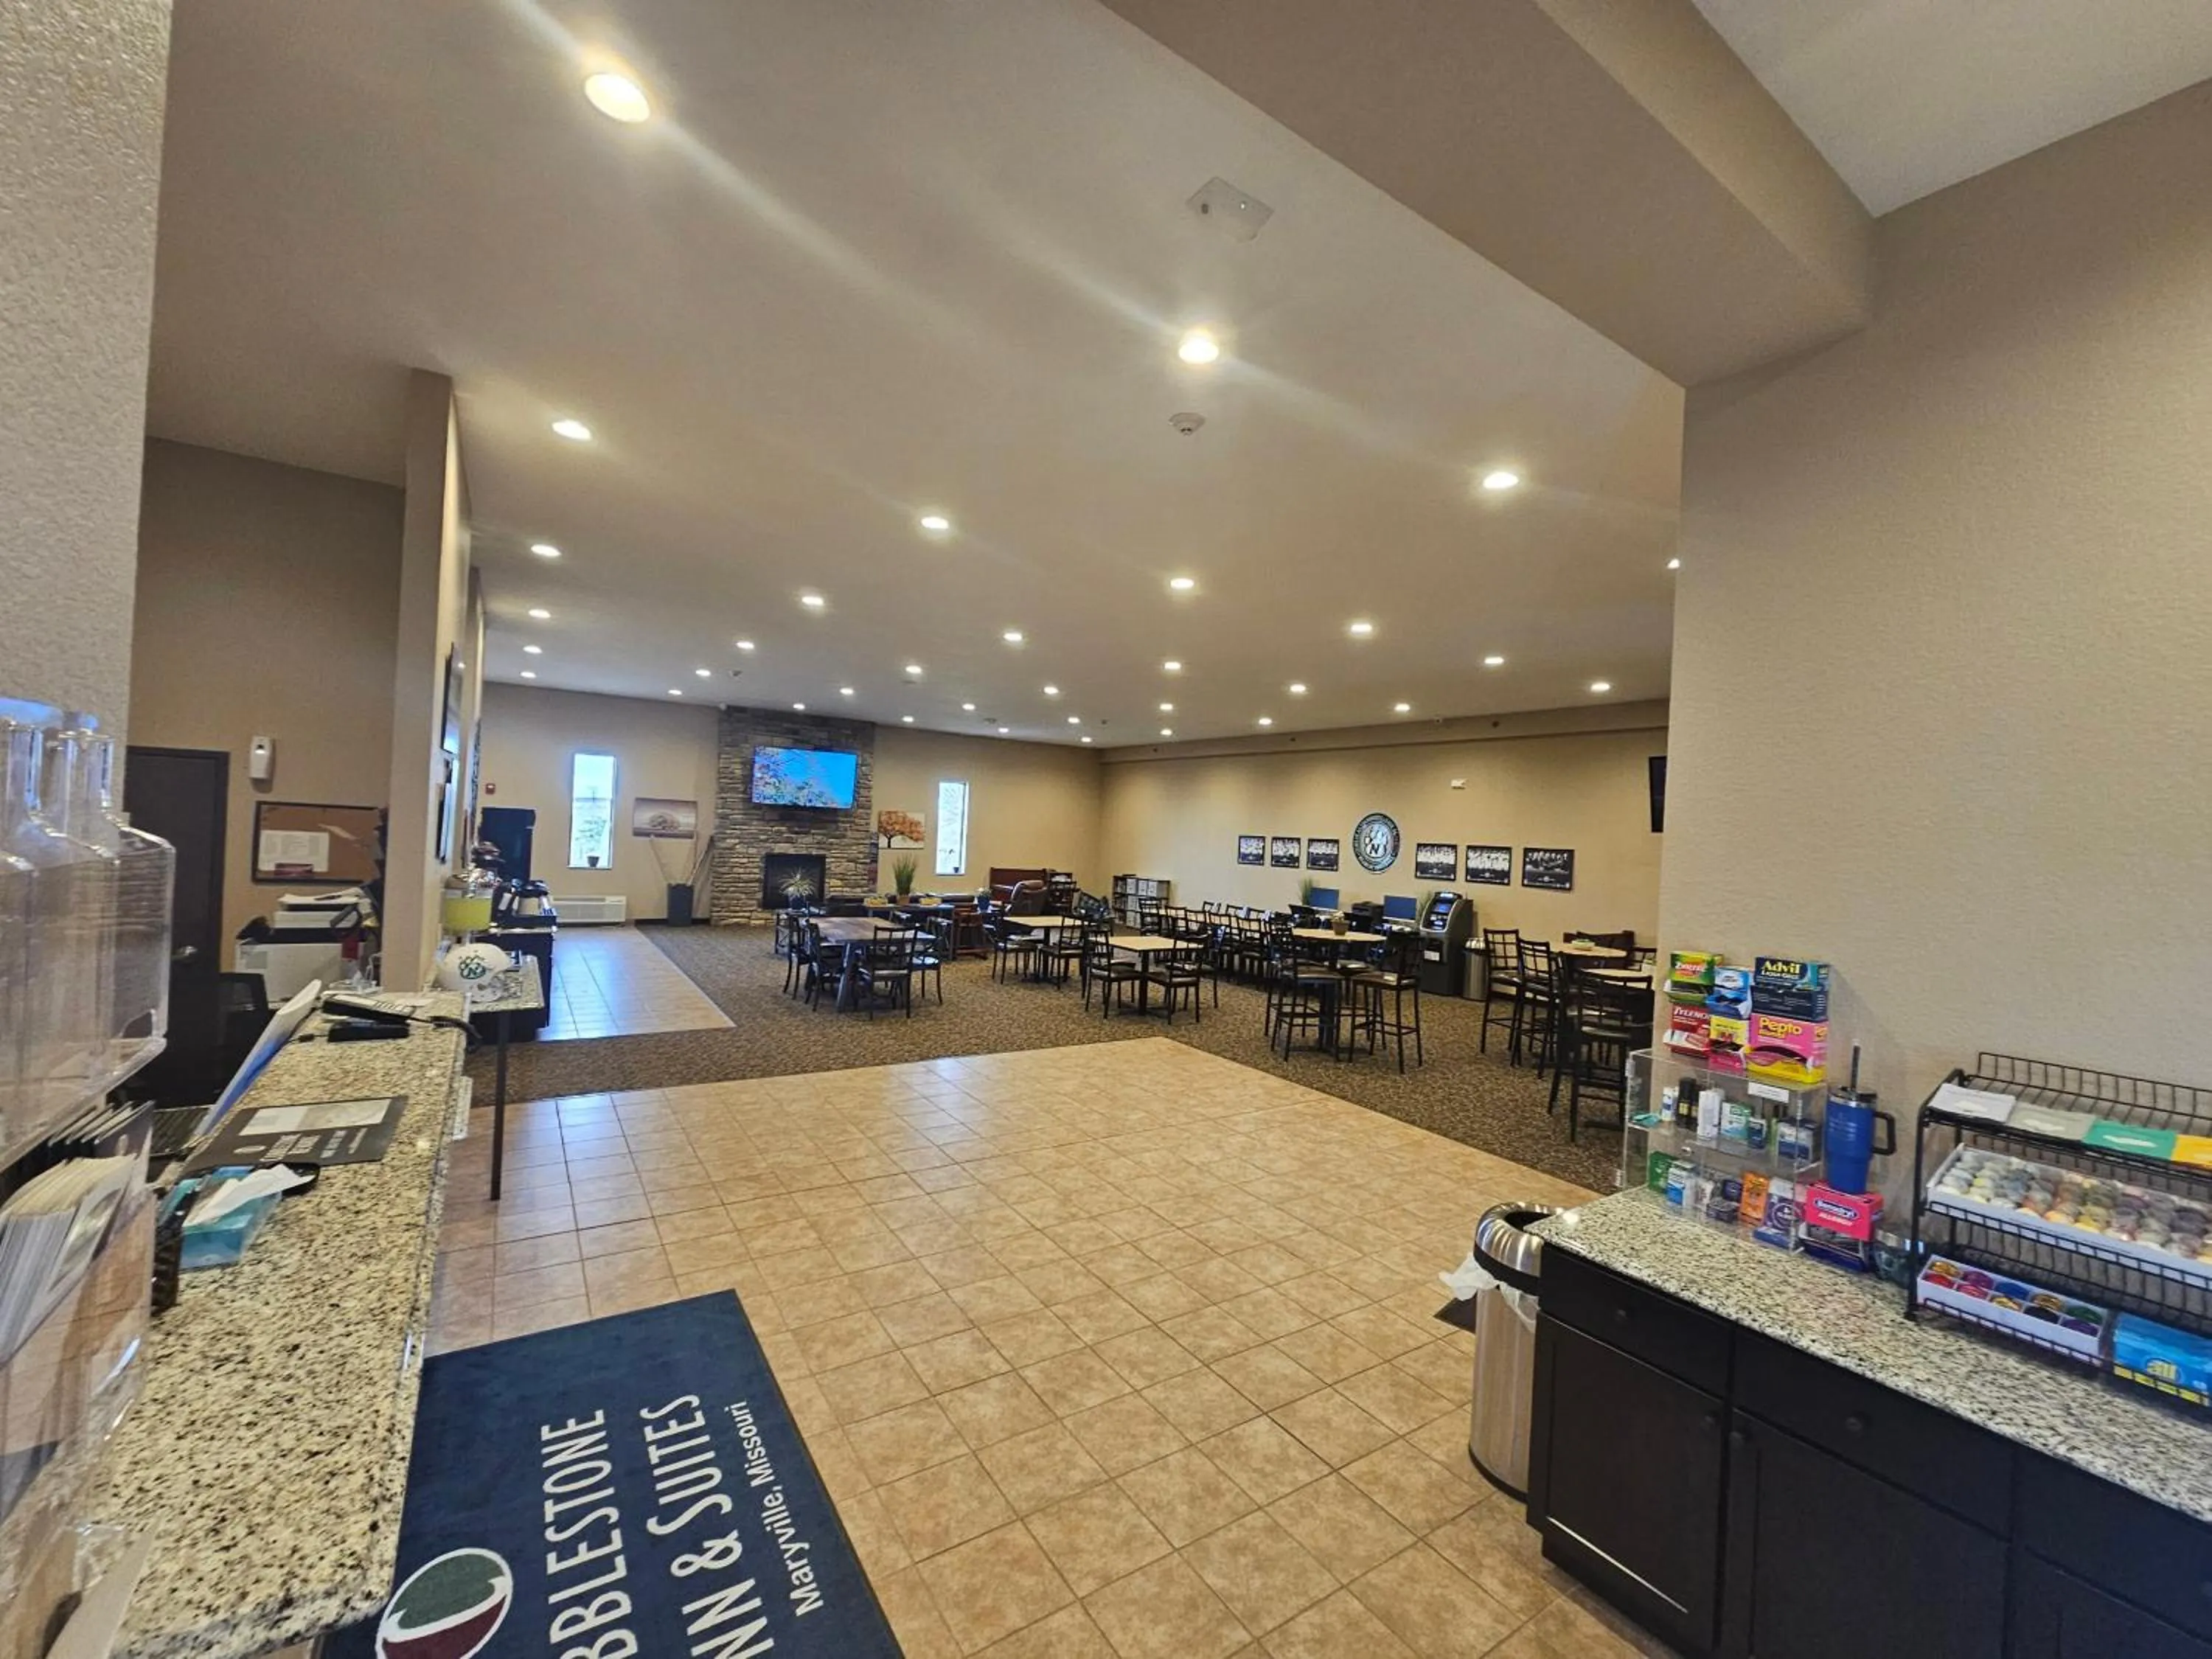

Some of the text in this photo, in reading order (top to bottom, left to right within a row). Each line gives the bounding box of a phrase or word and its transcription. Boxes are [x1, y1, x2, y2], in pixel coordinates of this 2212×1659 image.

[1761, 961, 1801, 973] Advil
[1759, 1017, 1802, 1035] Pepto
[639, 1394, 732, 1535] SUITES
[724, 1401, 824, 1616] Maryville, Missouri
[670, 1528, 742, 1577] &
